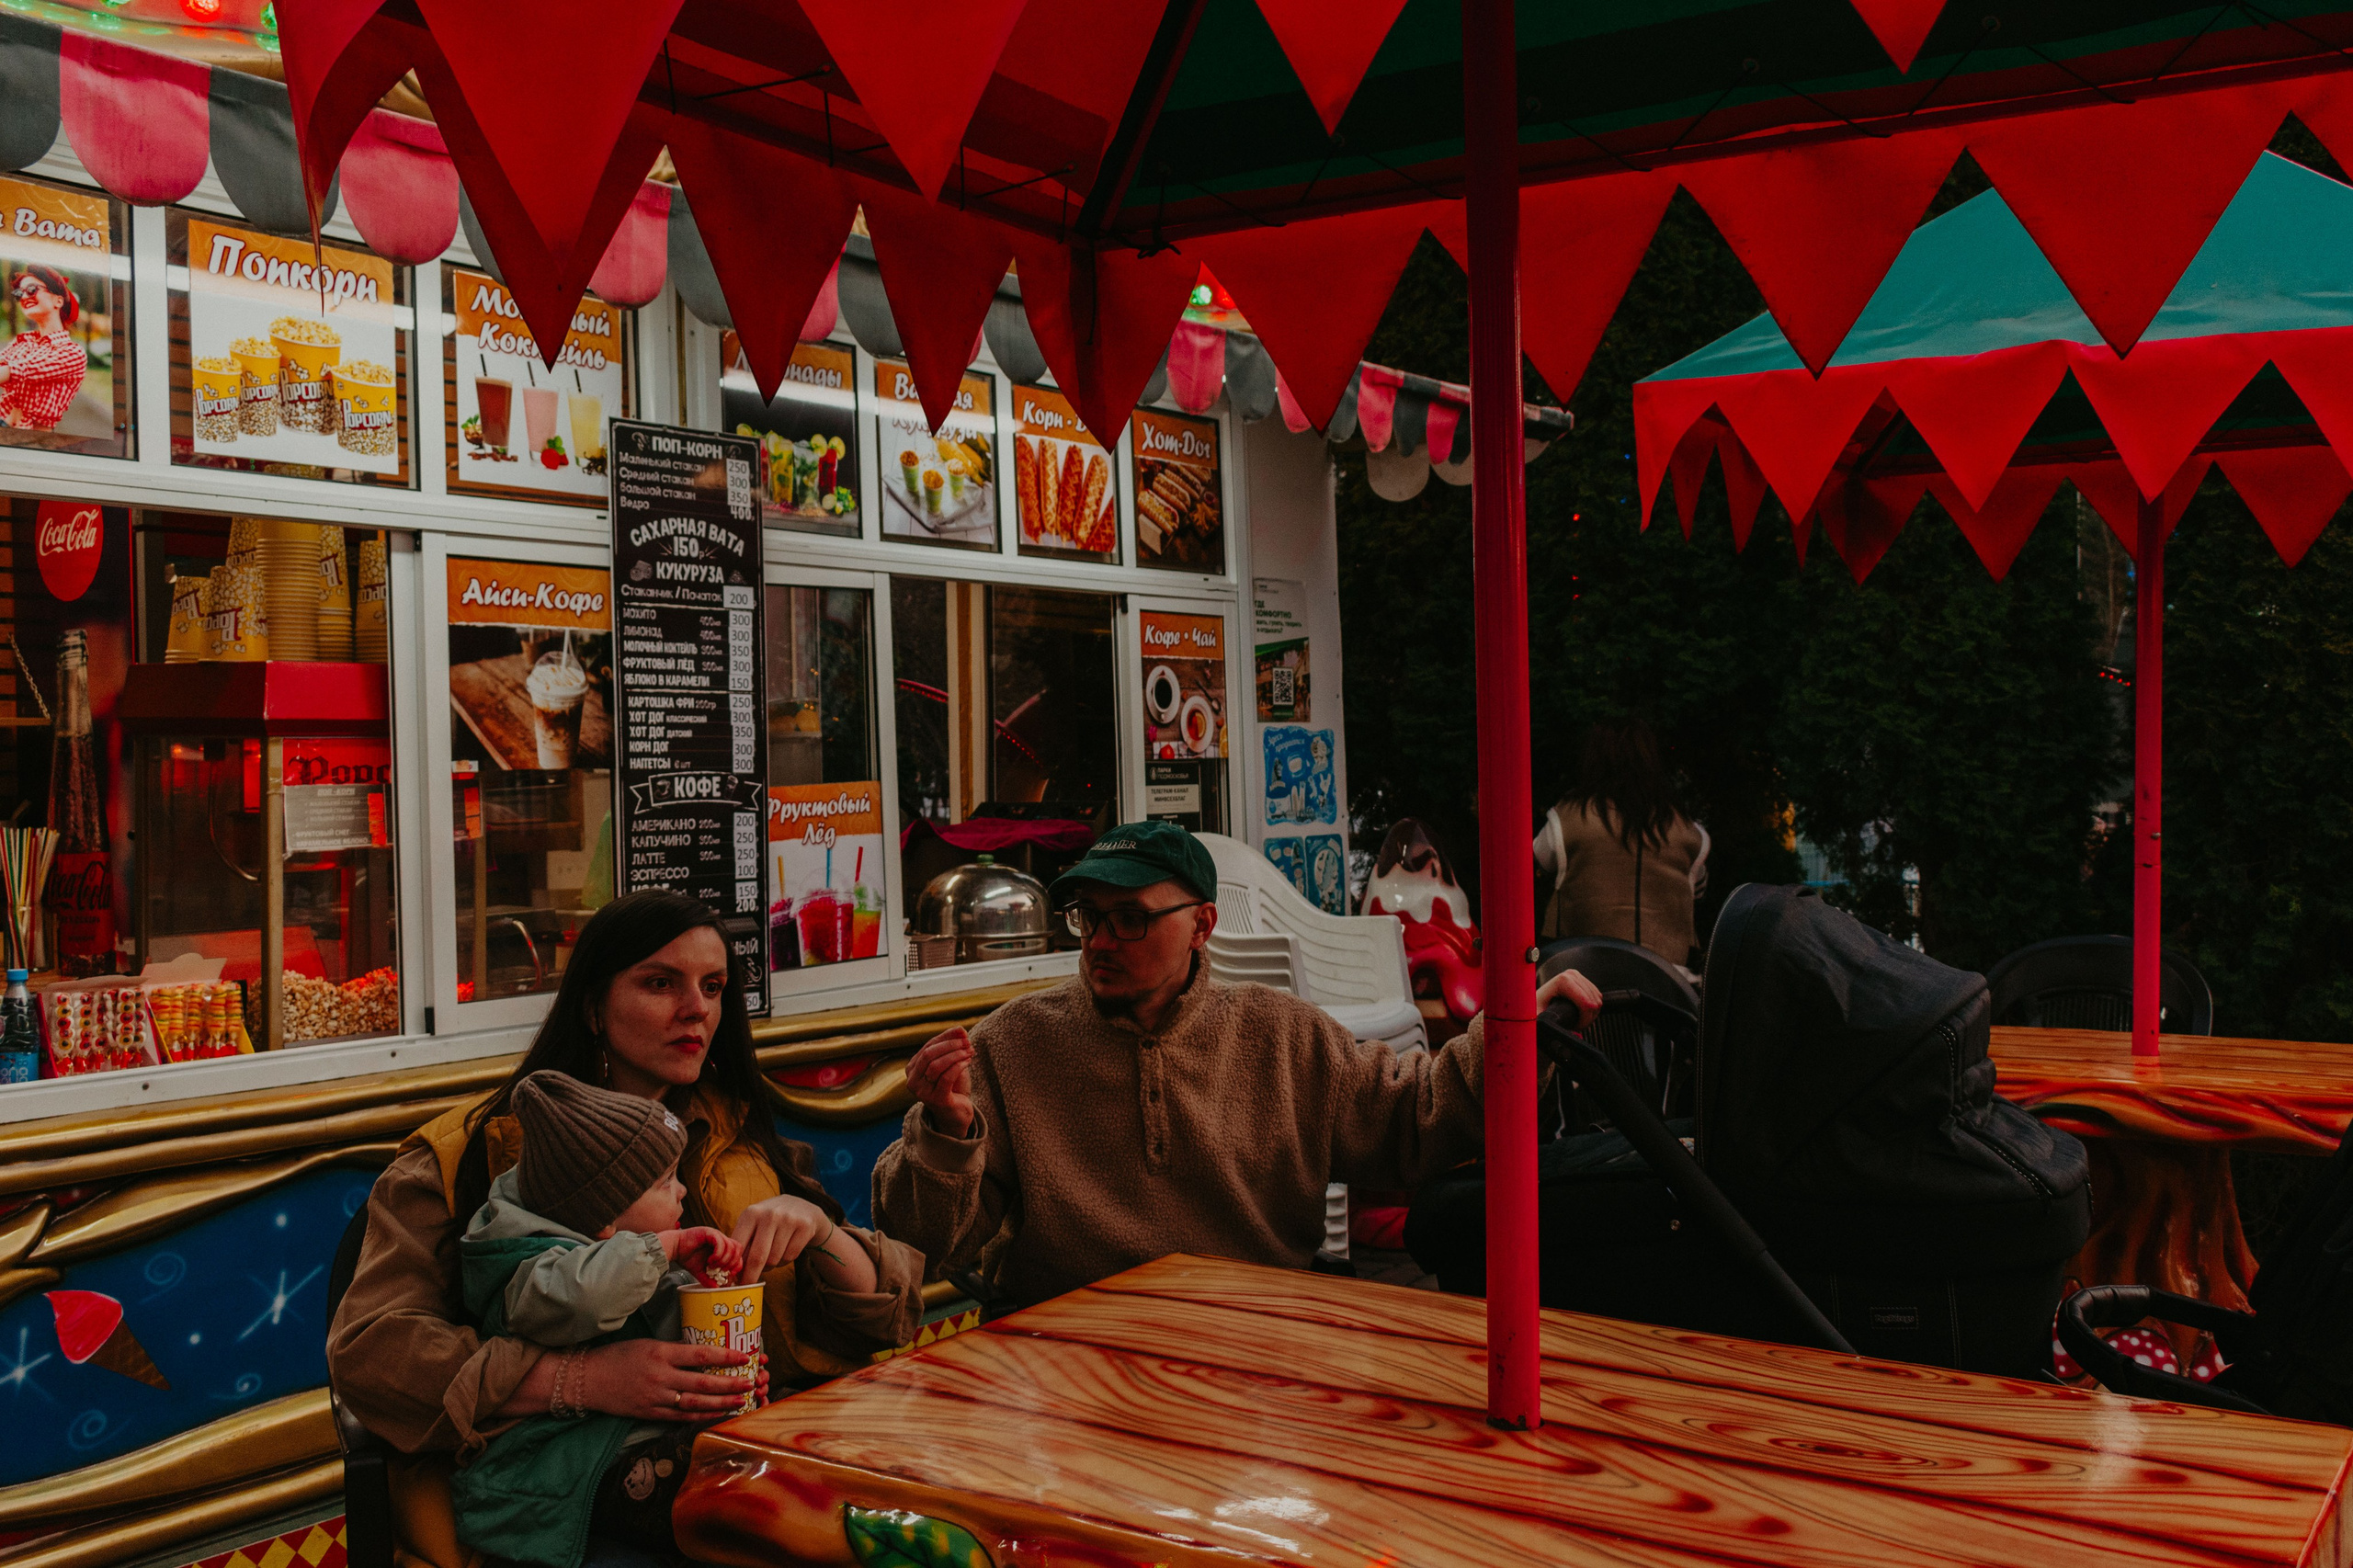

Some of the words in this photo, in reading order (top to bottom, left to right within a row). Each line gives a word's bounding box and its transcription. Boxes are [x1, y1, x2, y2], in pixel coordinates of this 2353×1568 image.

[13, 207, 101, 248] Вата
[208, 233, 379, 306] Попкорн
[1022, 399, 1064, 432] Корн
[728, 460, 748, 474] 250
[729, 476, 748, 490] 300
[620, 495, 651, 512] Ведро
[729, 491, 749, 505] 350
[630, 517, 707, 548] САХАРНАЯ
[708, 523, 745, 558] ВАТА
[655, 561, 725, 585] КУКУРУЗА
[460, 577, 604, 617] Айси-Кофе
[729, 593, 749, 606] 200
[731, 613, 751, 627] 300
[731, 630, 751, 643] 300
[1144, 624, 1181, 650] Кофе
[1192, 627, 1217, 647] Чай
[731, 645, 750, 658] 350
[732, 660, 752, 673] 300
[732, 676, 750, 689] 150
[732, 696, 751, 709] 250
[628, 710, 647, 723] ХОТ
[733, 711, 751, 724] 300
[629, 725, 647, 738] ХОТ
[734, 725, 754, 738] 350
[629, 740, 652, 753] КОРН
[734, 743, 753, 756] 300
[734, 757, 753, 771] 300
[674, 775, 722, 799] КОФЕ
[631, 817, 697, 833] АМЕРИКАНО
[736, 815, 755, 827] 200
[631, 833, 692, 848] КАПУЧИНО
[736, 832, 755, 844] 250
[801, 820, 837, 850] Лёд
[631, 851, 665, 866] ЛАТТЕ
[737, 847, 756, 860] 250
[631, 866, 690, 881] ЭСПРЕССО
[737, 864, 755, 877] 100
[739, 885, 756, 898] 150
